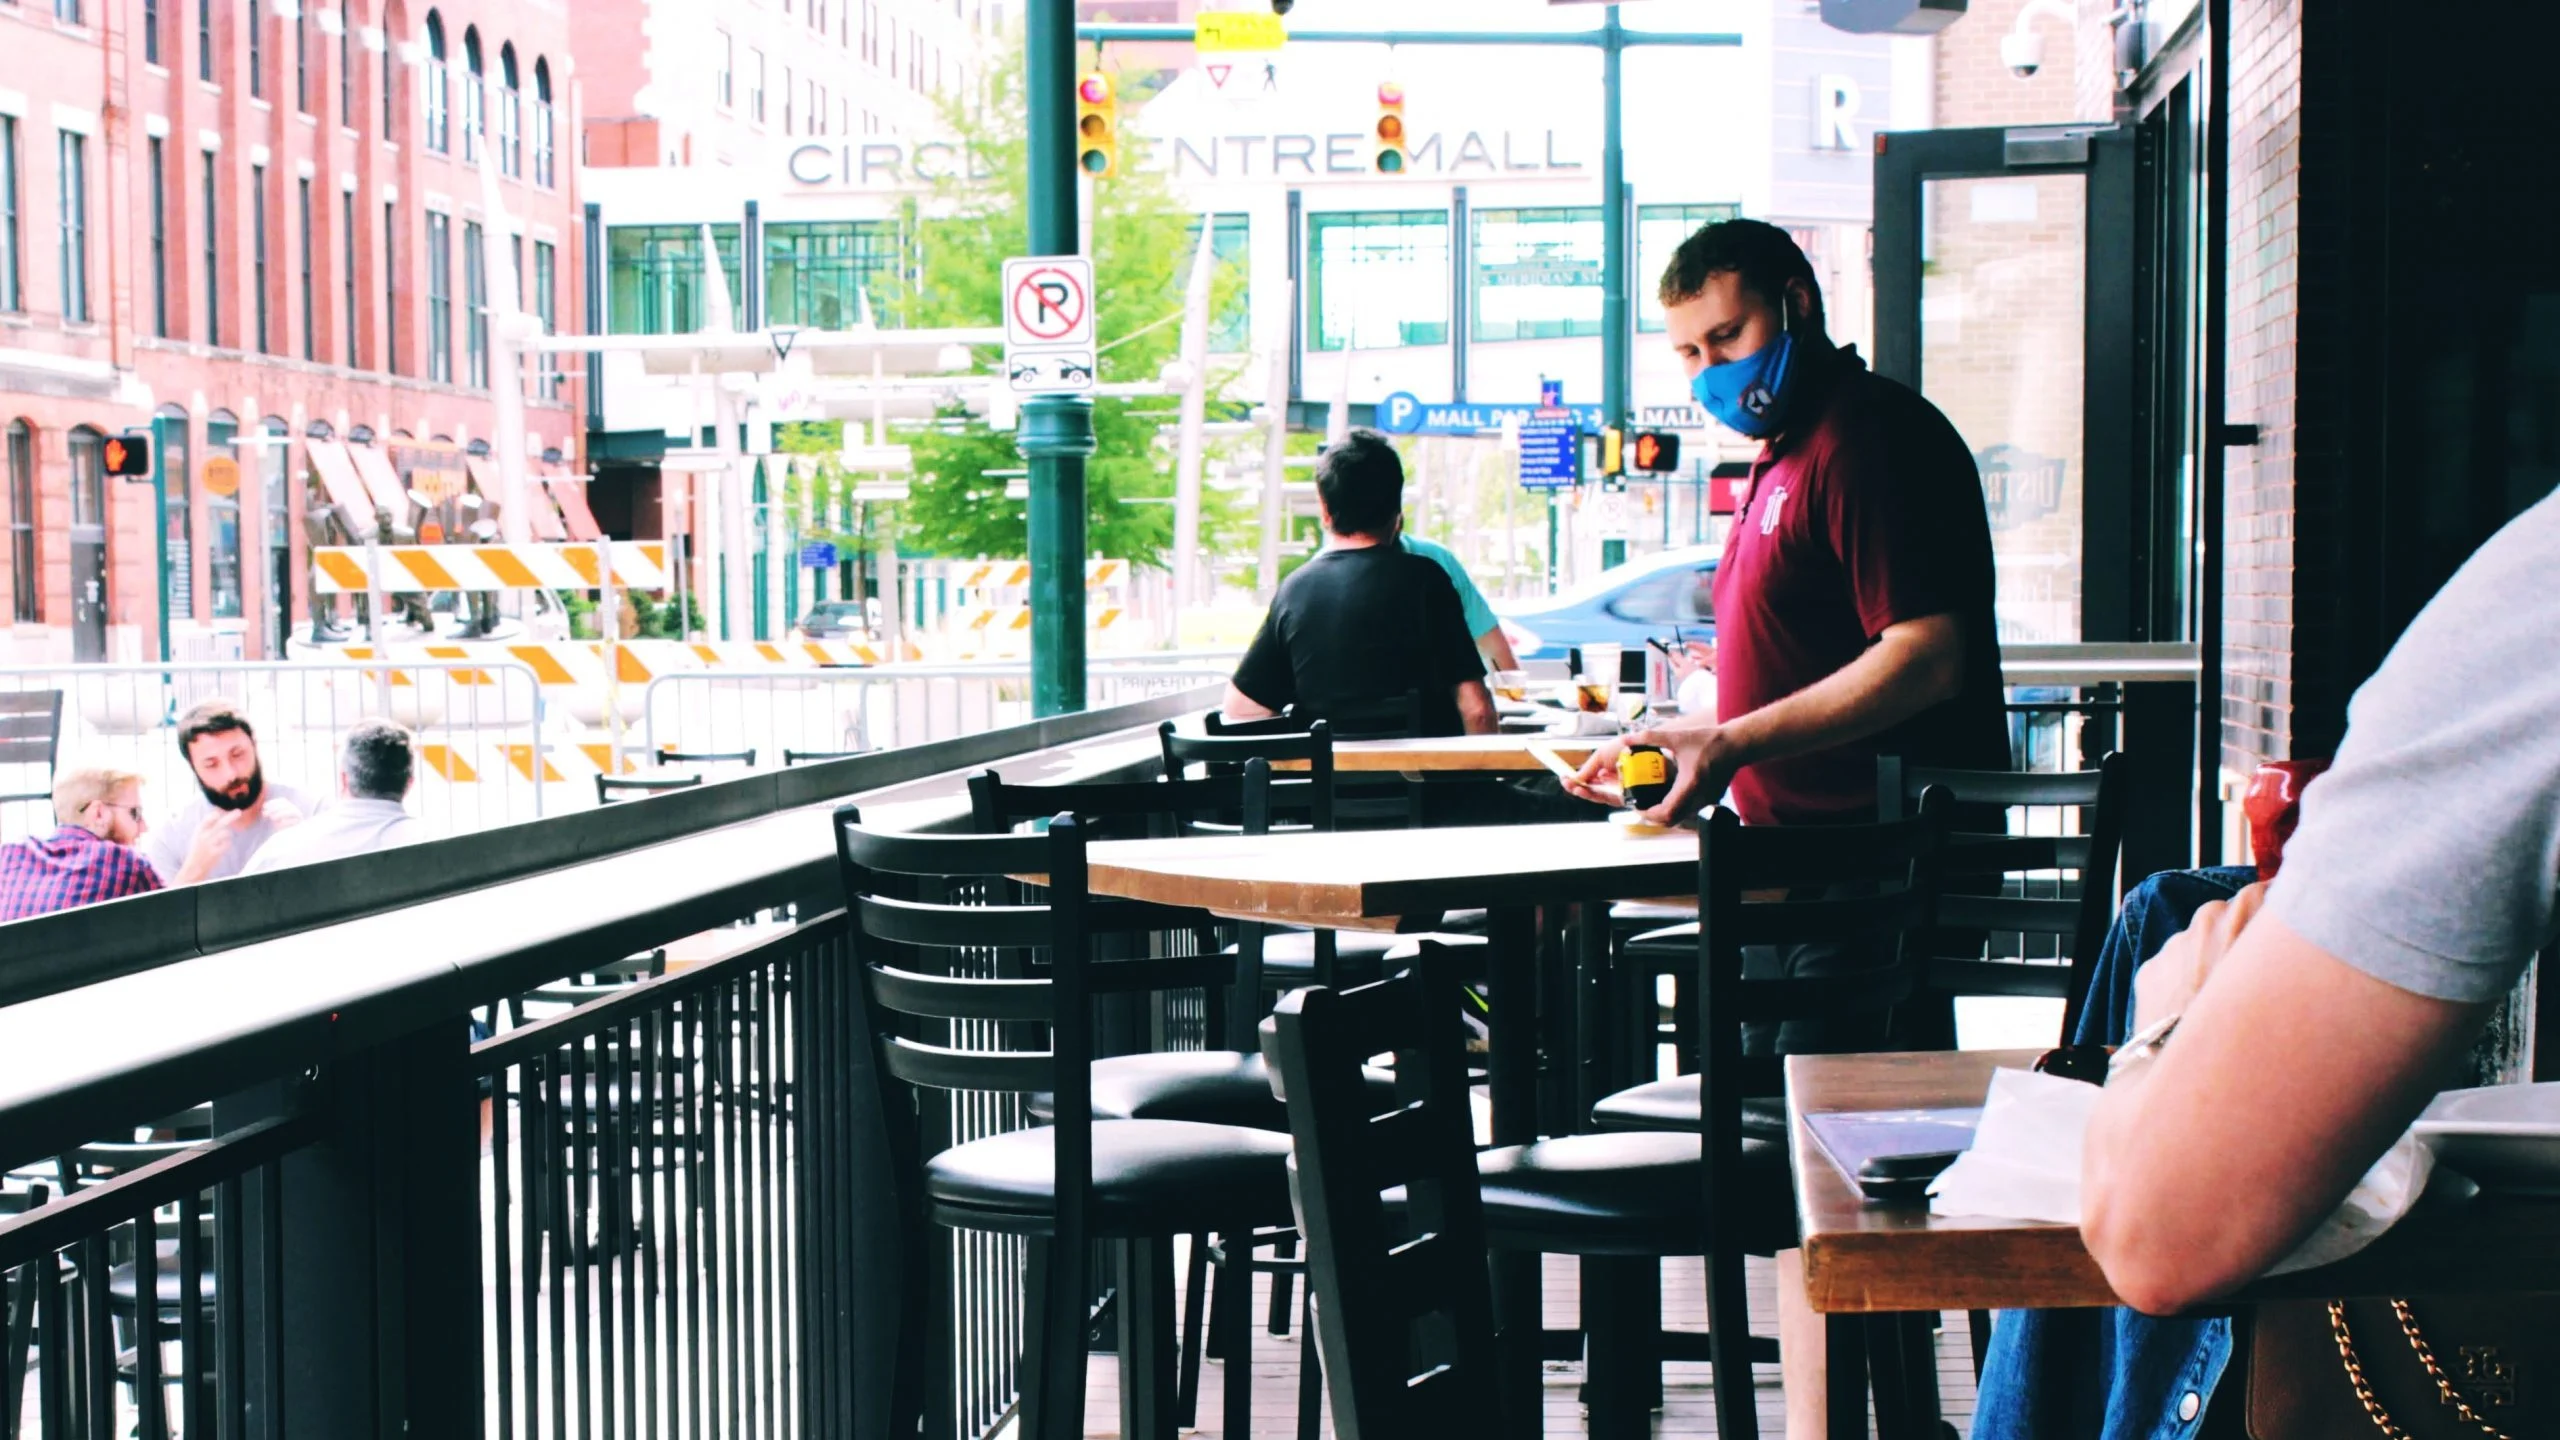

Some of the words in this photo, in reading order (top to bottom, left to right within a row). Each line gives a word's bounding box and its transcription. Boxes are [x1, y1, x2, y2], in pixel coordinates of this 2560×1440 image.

[1819, 73, 1861, 149] R
[788, 143, 994, 185] CIRCL
[1133, 133, 1366, 176] ENTRE
[1391, 397, 1413, 427] P
[1427, 409, 1485, 427] MALL
